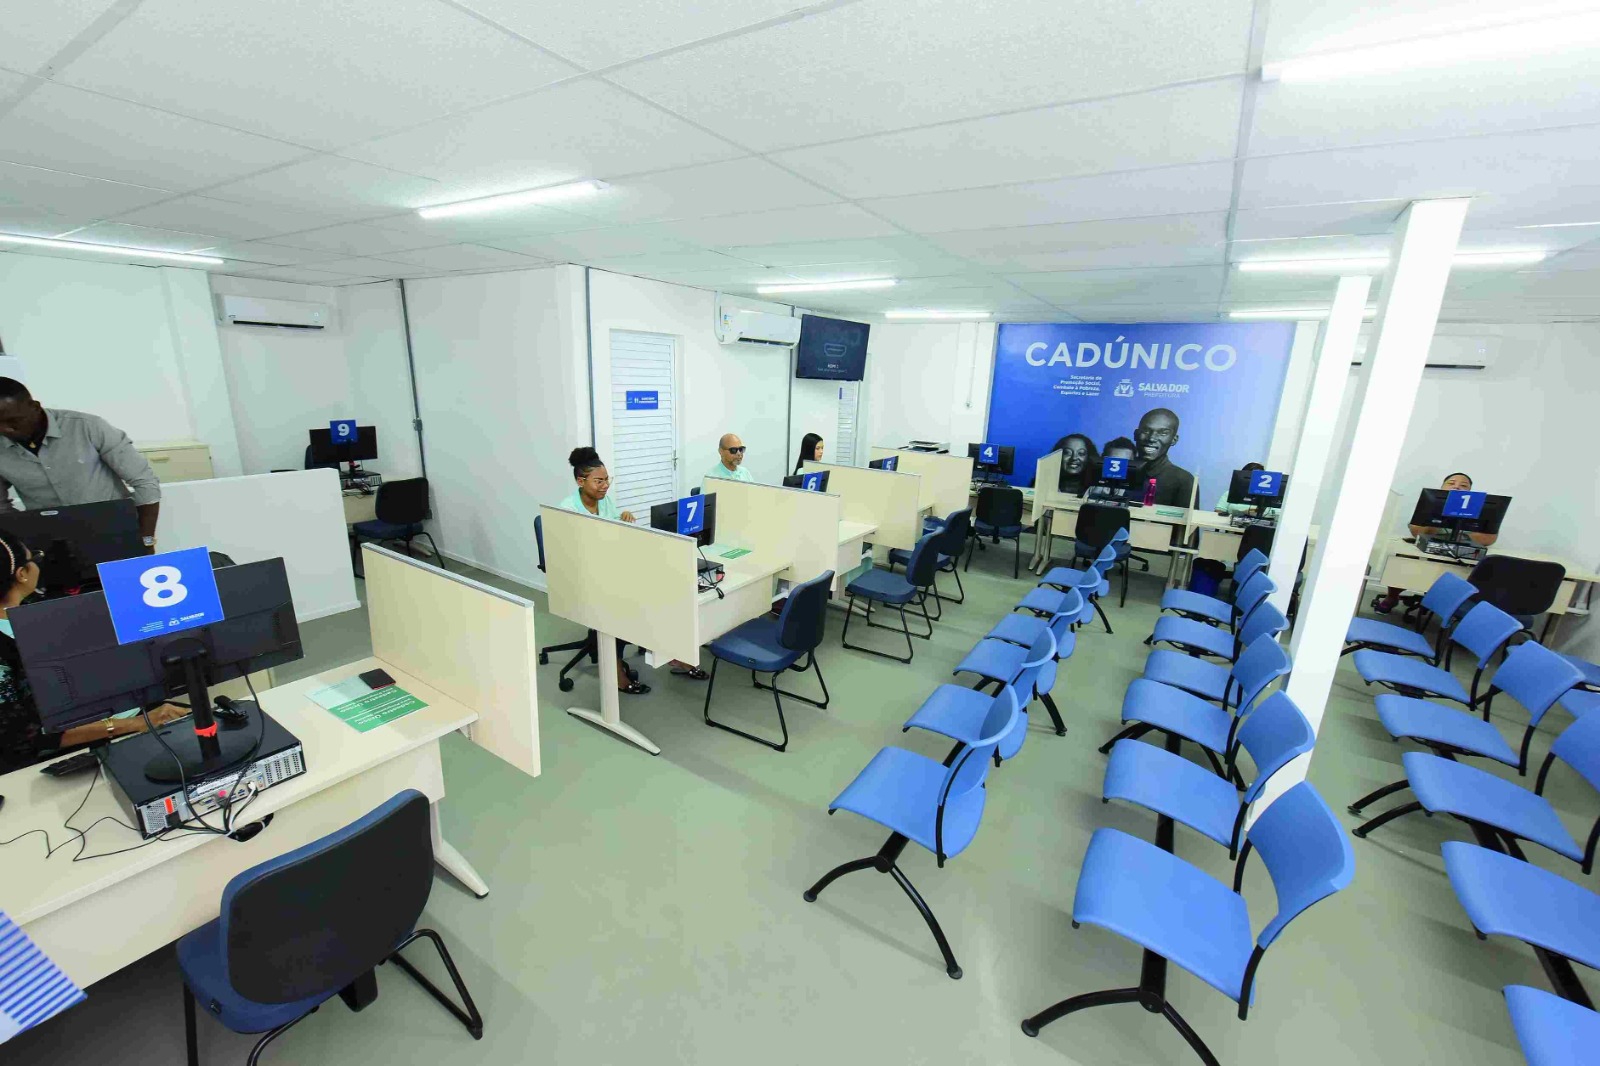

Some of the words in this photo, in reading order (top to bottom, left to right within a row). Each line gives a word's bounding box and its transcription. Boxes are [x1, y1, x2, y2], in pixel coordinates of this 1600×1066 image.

[1026, 336, 1237, 371] CADÚNICO
[1138, 383, 1190, 393] SALVADOR
[338, 424, 350, 436] 9
[984, 446, 994, 458] 4
[1110, 460, 1121, 473] 3
[807, 476, 817, 491] 6
[1258, 474, 1271, 488] 2
[1461, 495, 1470, 509] 1
[686, 501, 698, 523] 7
[139, 565, 188, 608] 8
